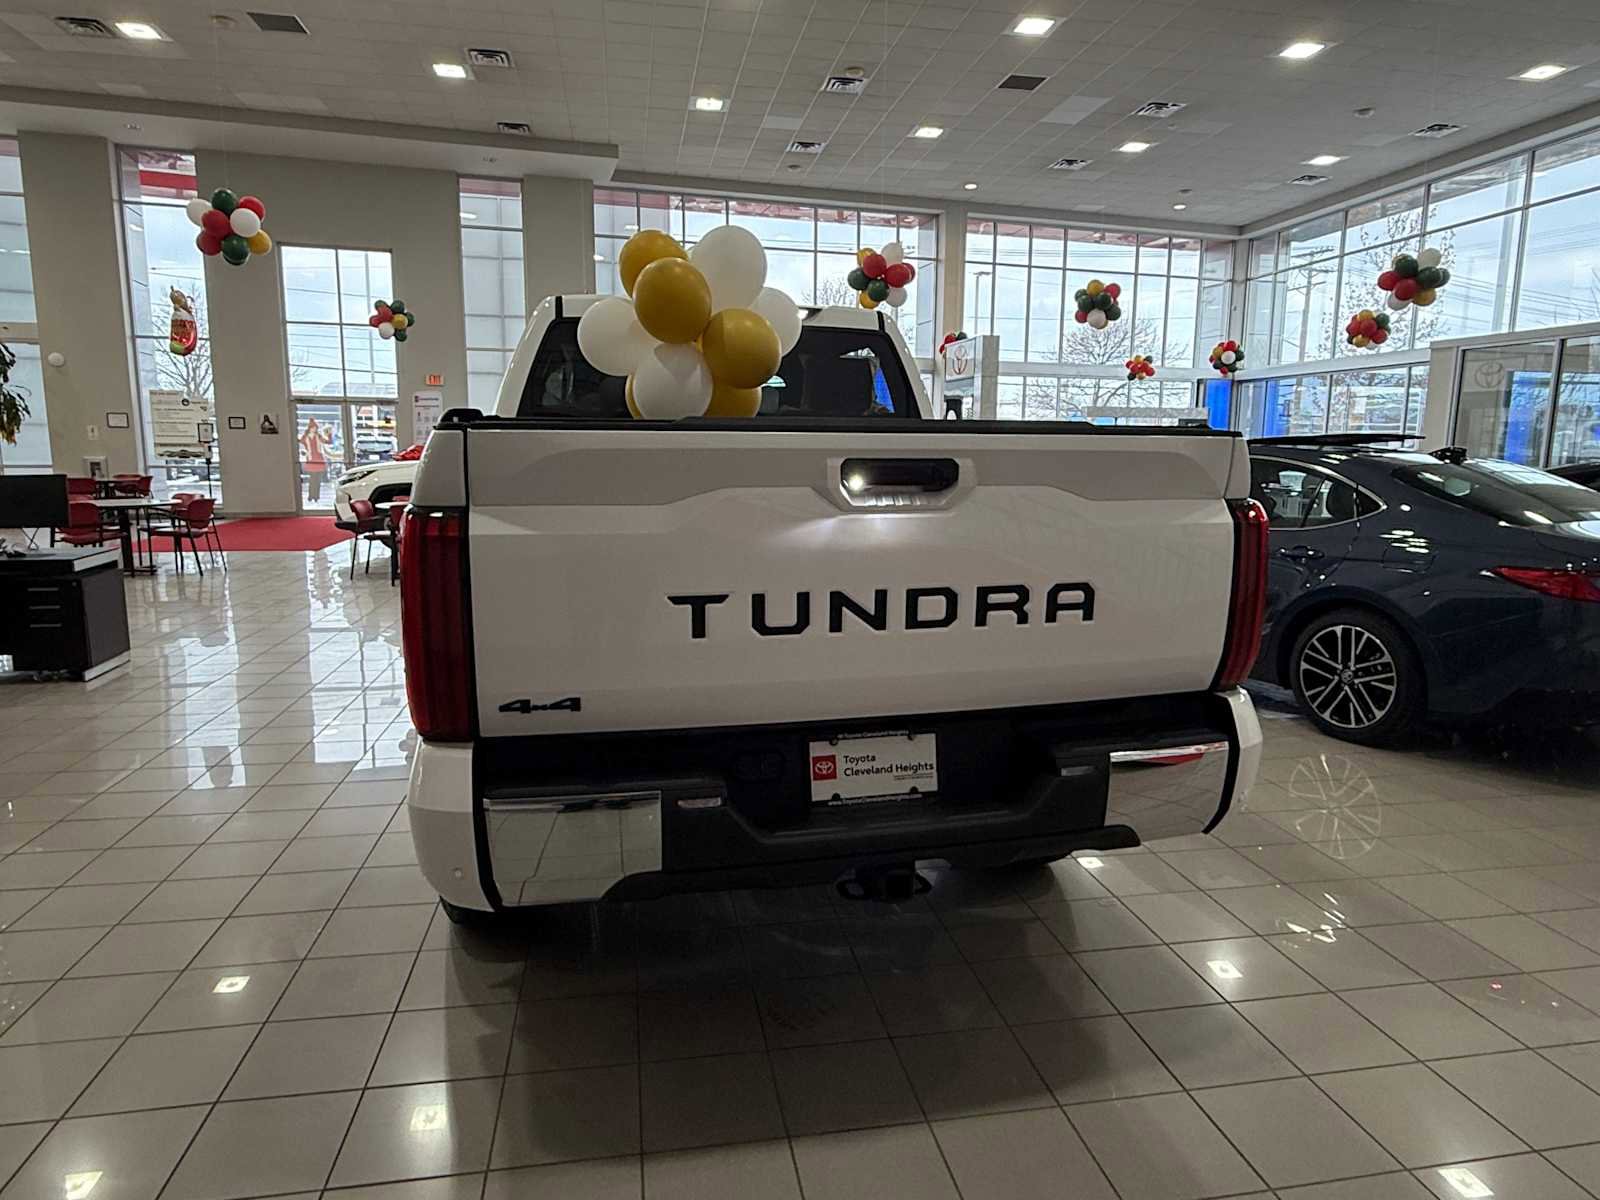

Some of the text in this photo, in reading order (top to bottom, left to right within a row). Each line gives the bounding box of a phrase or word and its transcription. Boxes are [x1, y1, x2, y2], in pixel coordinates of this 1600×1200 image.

[667, 582, 1096, 639] TUNDRA
[843, 754, 877, 766] Toyota
[844, 764, 894, 777] Cleveland
[895, 761, 935, 774] Heights
